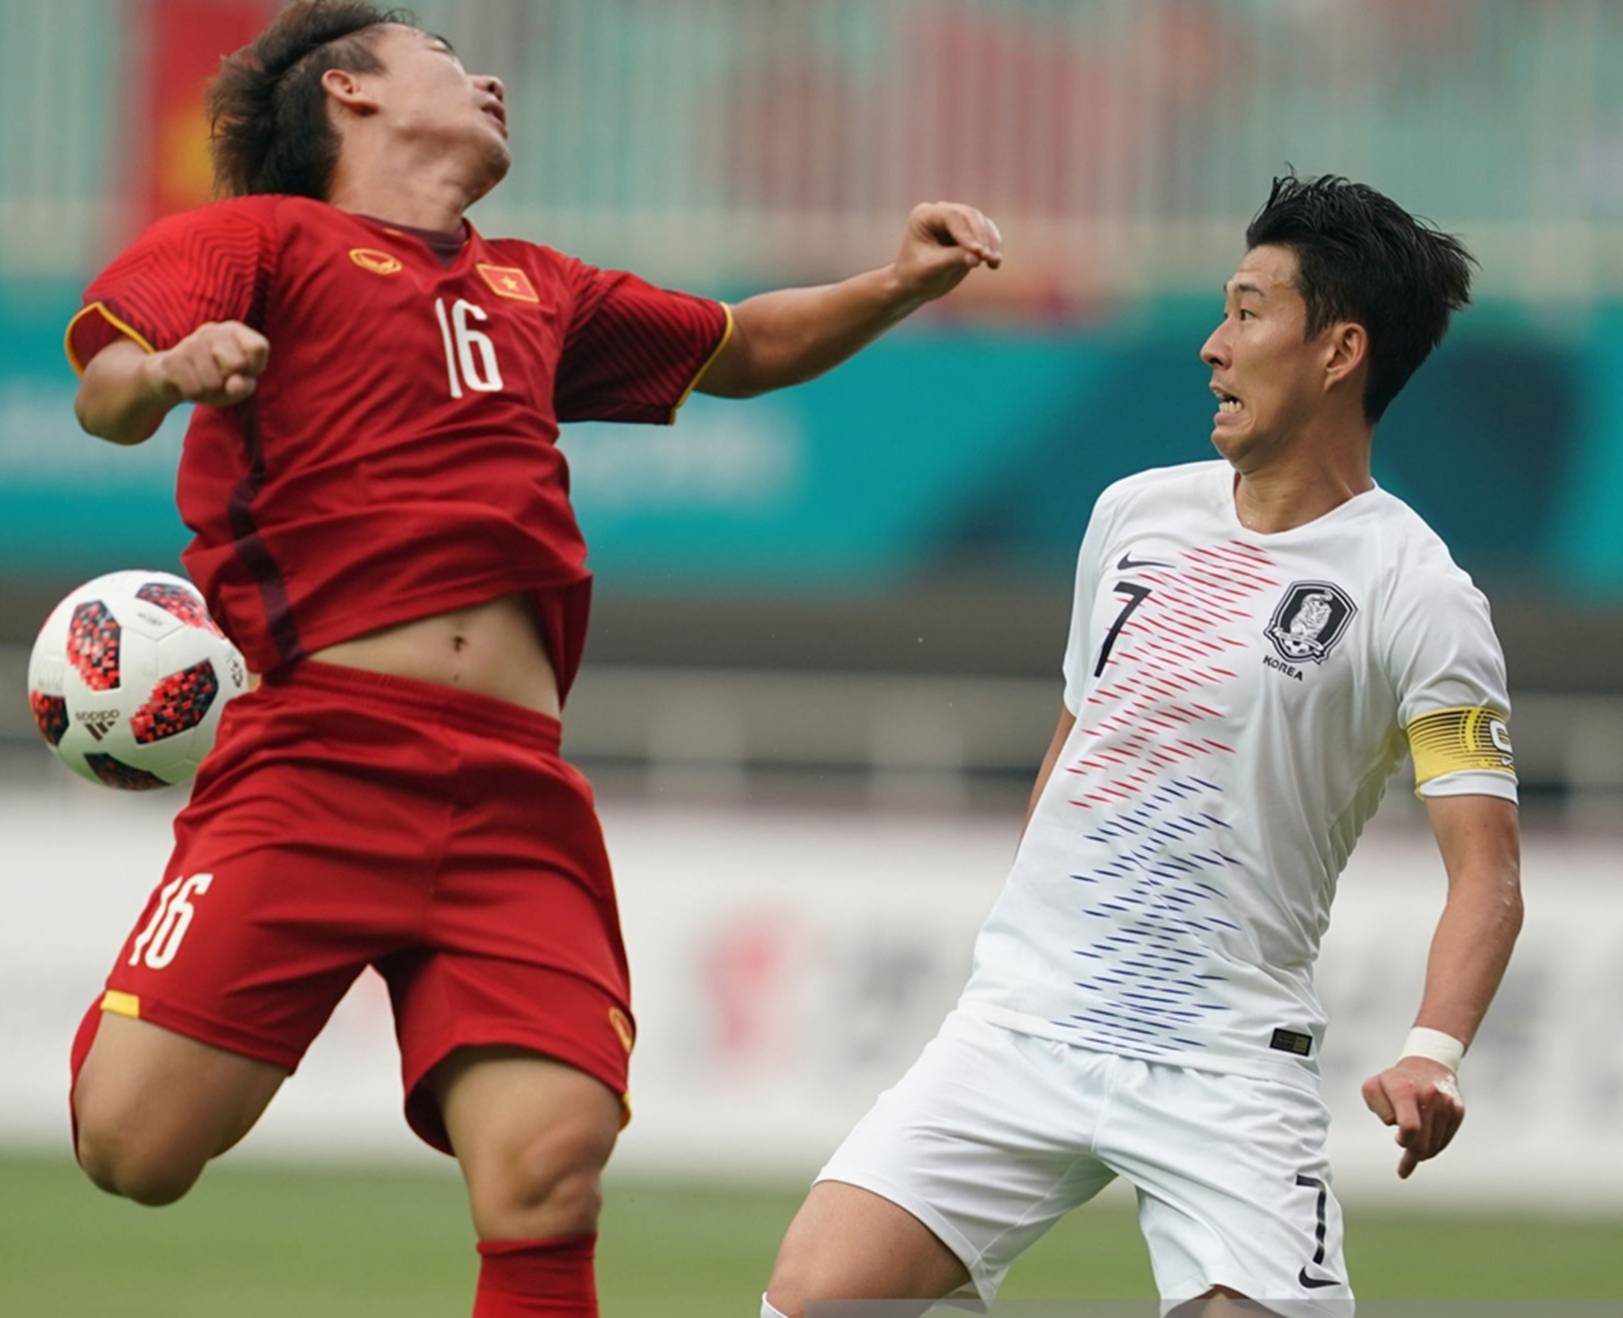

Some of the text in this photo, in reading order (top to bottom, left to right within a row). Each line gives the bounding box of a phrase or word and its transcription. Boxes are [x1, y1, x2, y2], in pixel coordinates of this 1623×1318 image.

[435, 297, 504, 398] 16
[1094, 581, 1152, 678] 7
[1262, 655, 1304, 682] KOREA
[128, 872, 214, 970] 16
[1296, 1174, 1327, 1265] 7
